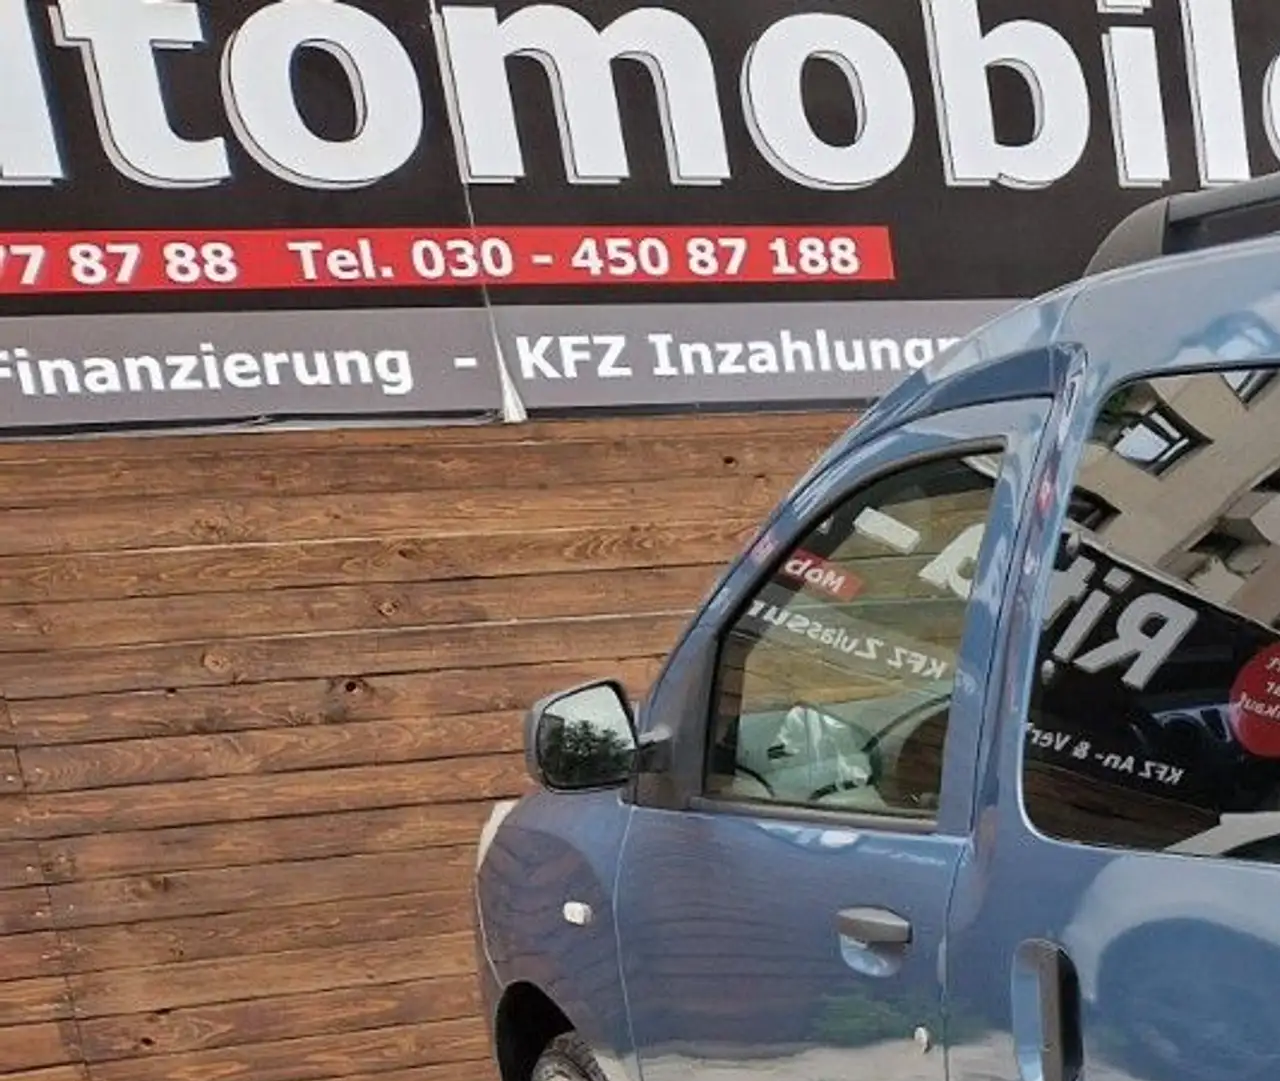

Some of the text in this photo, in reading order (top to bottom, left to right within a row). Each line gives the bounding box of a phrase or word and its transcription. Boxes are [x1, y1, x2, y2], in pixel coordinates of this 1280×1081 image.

[0, 243, 46, 286] 7
[68, 242, 142, 286] 87
[162, 241, 239, 284] 88
[287, 238, 395, 281] Tel.
[411, 238, 514, 279] 030
[571, 237, 670, 277] 450
[686, 237, 749, 276] 87
[769, 236, 861, 275] 188
[515, 334, 633, 379] KFZ
